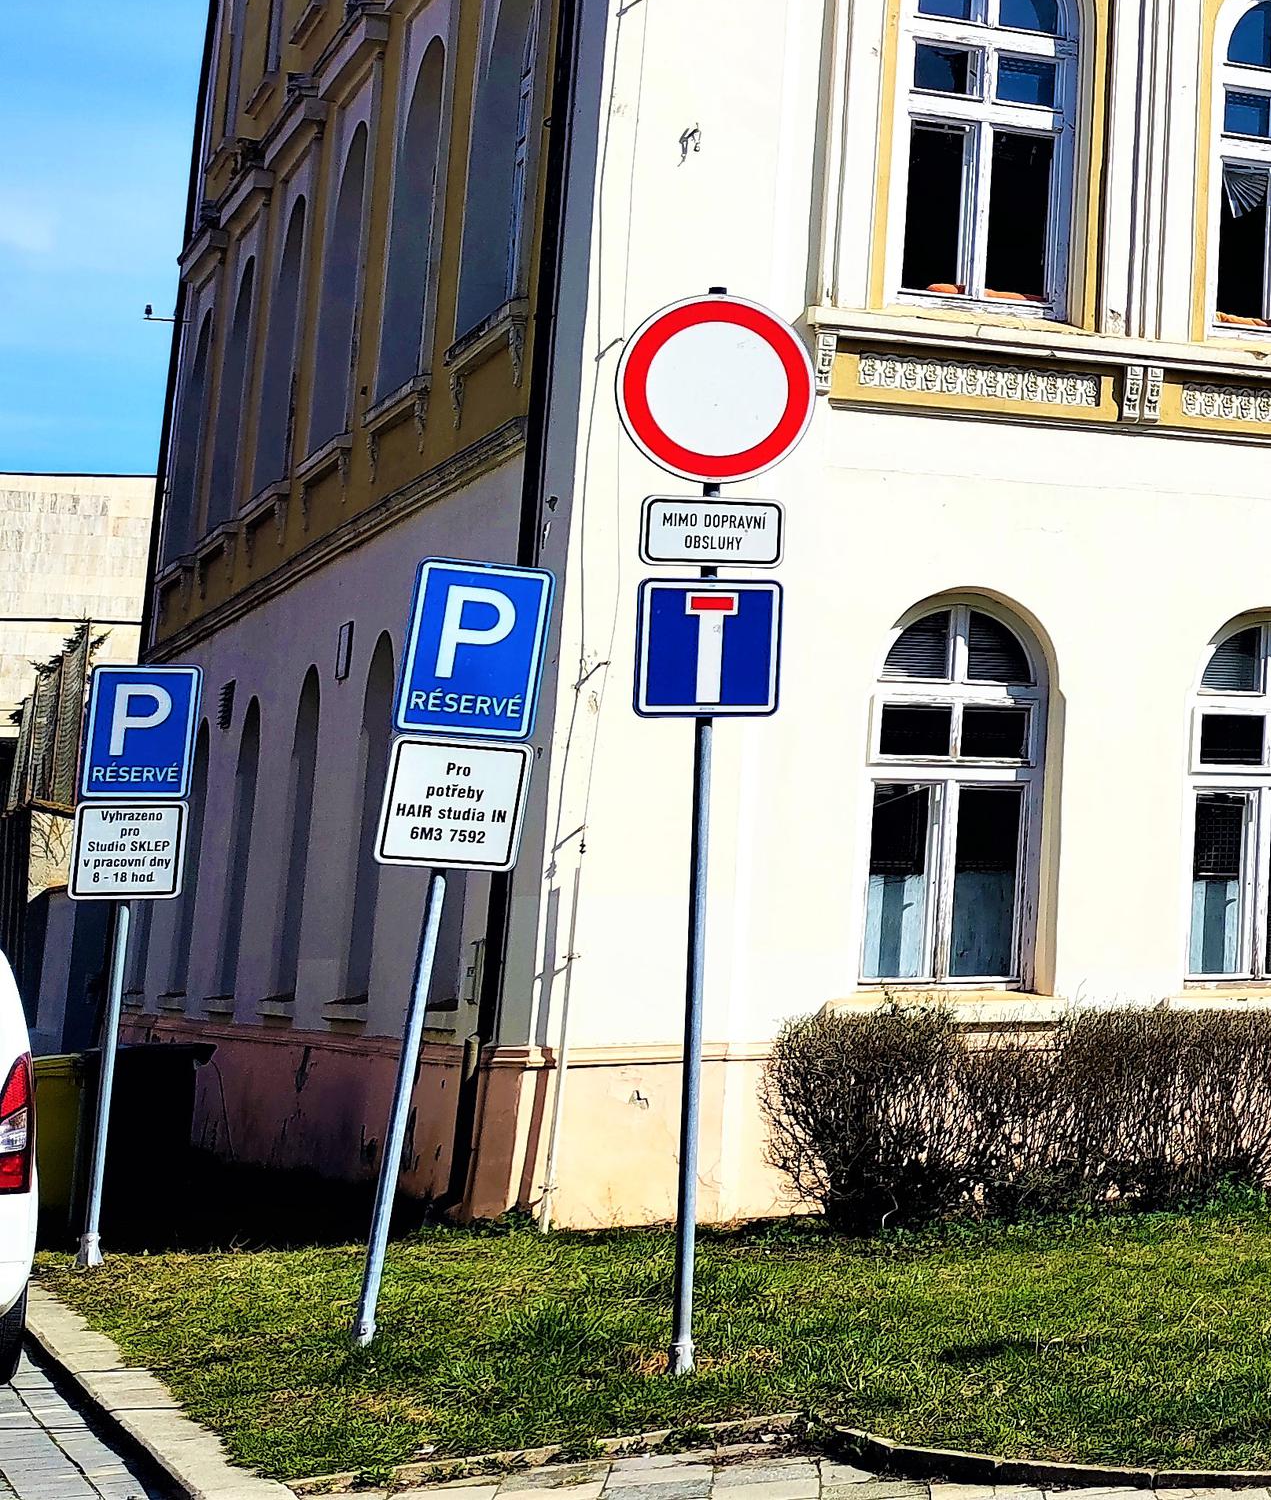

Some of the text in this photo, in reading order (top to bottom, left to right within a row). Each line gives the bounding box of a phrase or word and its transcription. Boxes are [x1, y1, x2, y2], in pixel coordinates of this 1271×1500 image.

[662, 512, 767, 530] MIMO DOPRAVNÍ
[684, 534, 743, 550] OBSLUHY
[434, 584, 517, 679] P
[409, 688, 522, 719] RÉSERVÉ
[109, 683, 172, 756] P
[92, 762, 180, 783] RÉSERVÉ
[446, 762, 471, 777] Pro
[425, 784, 484, 802] potřeby
[101, 810, 163, 823] Vyhrazeno
[396, 803, 507, 823] HAIR studia IN
[120, 827, 140, 839] pro
[410, 826, 486, 844] 6M3 7592
[87, 840, 170, 852] Studio SKLEP
[83, 855, 171, 869] v pracovní dny
[92, 872, 100, 883] 8
[113, 871, 127, 882] 18
